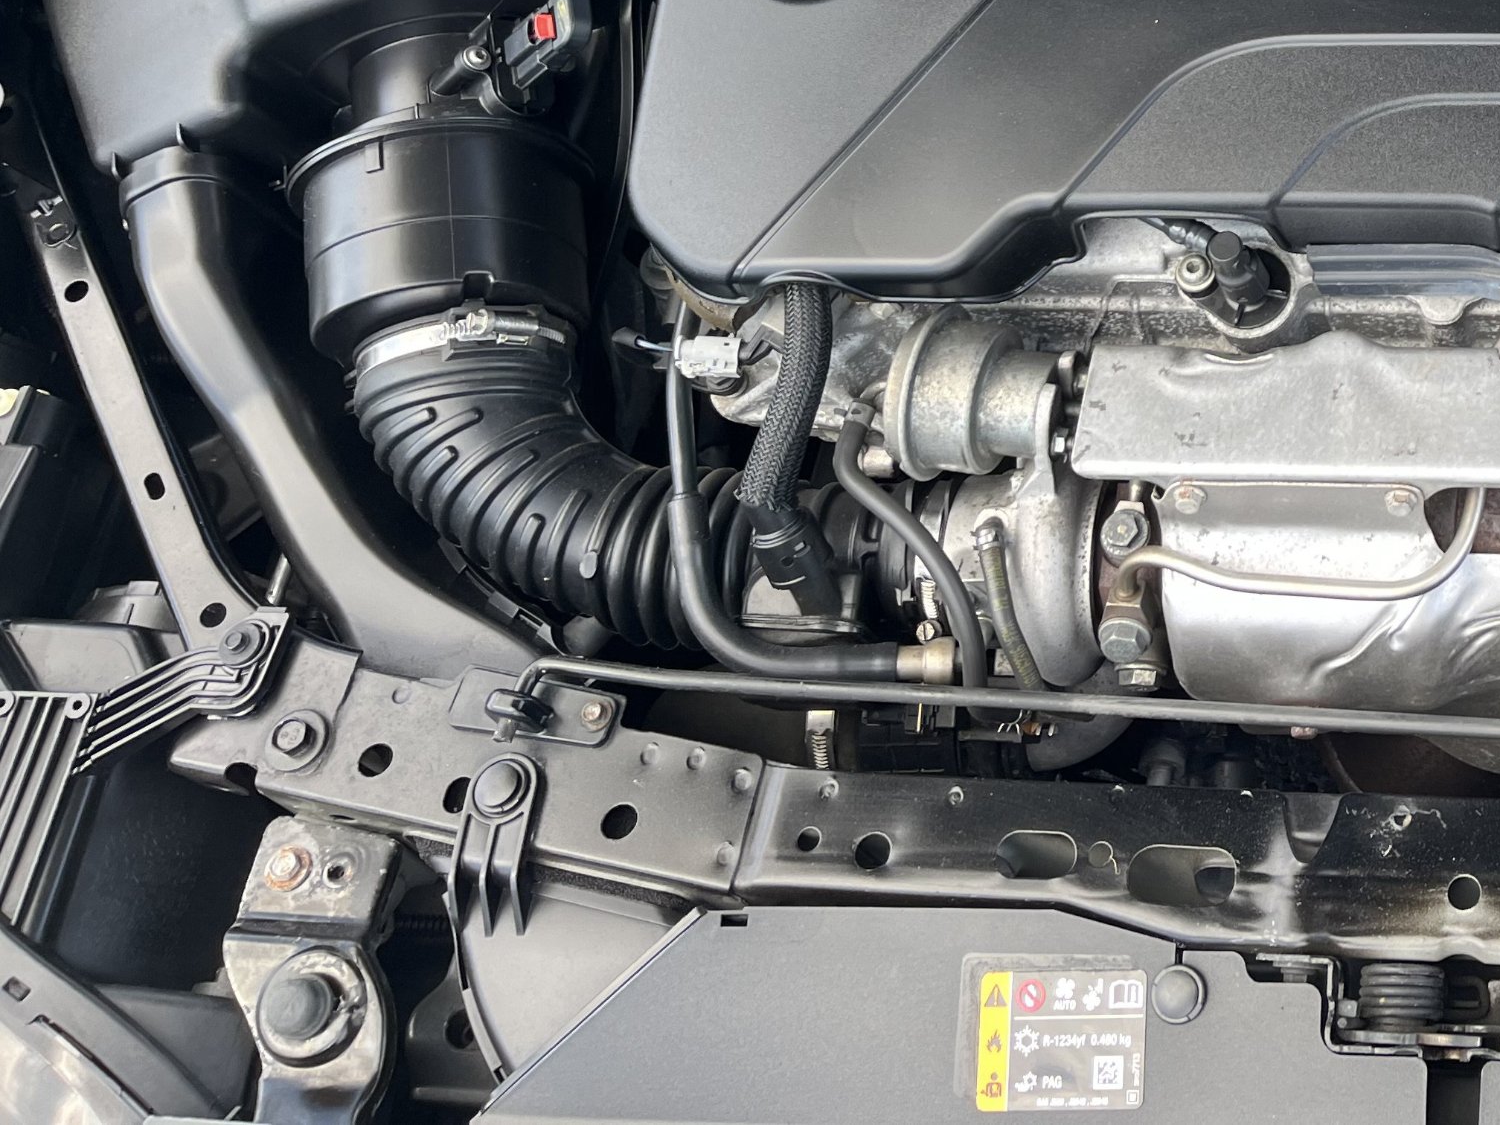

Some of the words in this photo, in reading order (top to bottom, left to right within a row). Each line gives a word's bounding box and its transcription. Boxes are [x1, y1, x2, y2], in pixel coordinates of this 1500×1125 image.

[1053, 1000, 1076, 1011] AUTO
[1042, 1033, 1086, 1049] R-1234yf
[1118, 1034, 1132, 1048] kg
[1042, 1075, 1062, 1089] PAG
